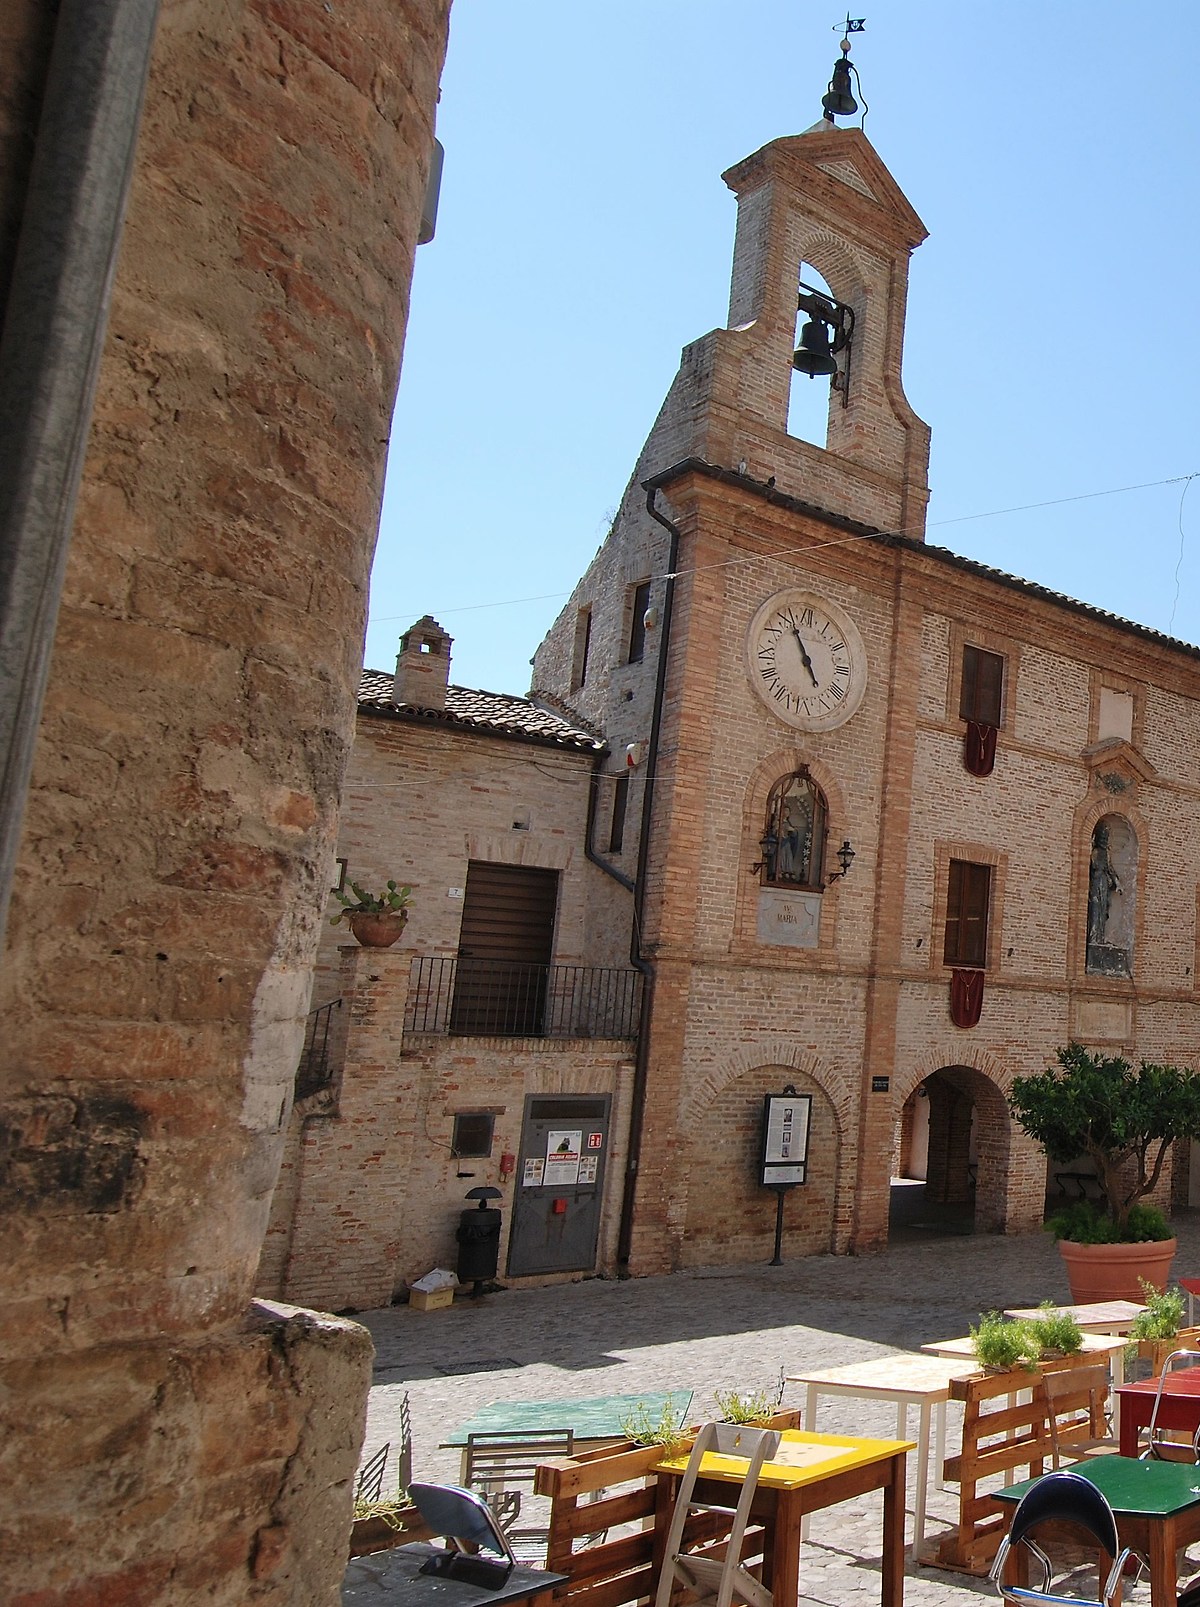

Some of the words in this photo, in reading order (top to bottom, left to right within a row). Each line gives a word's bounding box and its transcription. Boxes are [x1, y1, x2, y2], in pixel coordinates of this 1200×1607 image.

[763, 620, 783, 641] X
[820, 621, 831, 635] I
[831, 641, 845, 652] II
[835, 665, 849, 676] III
